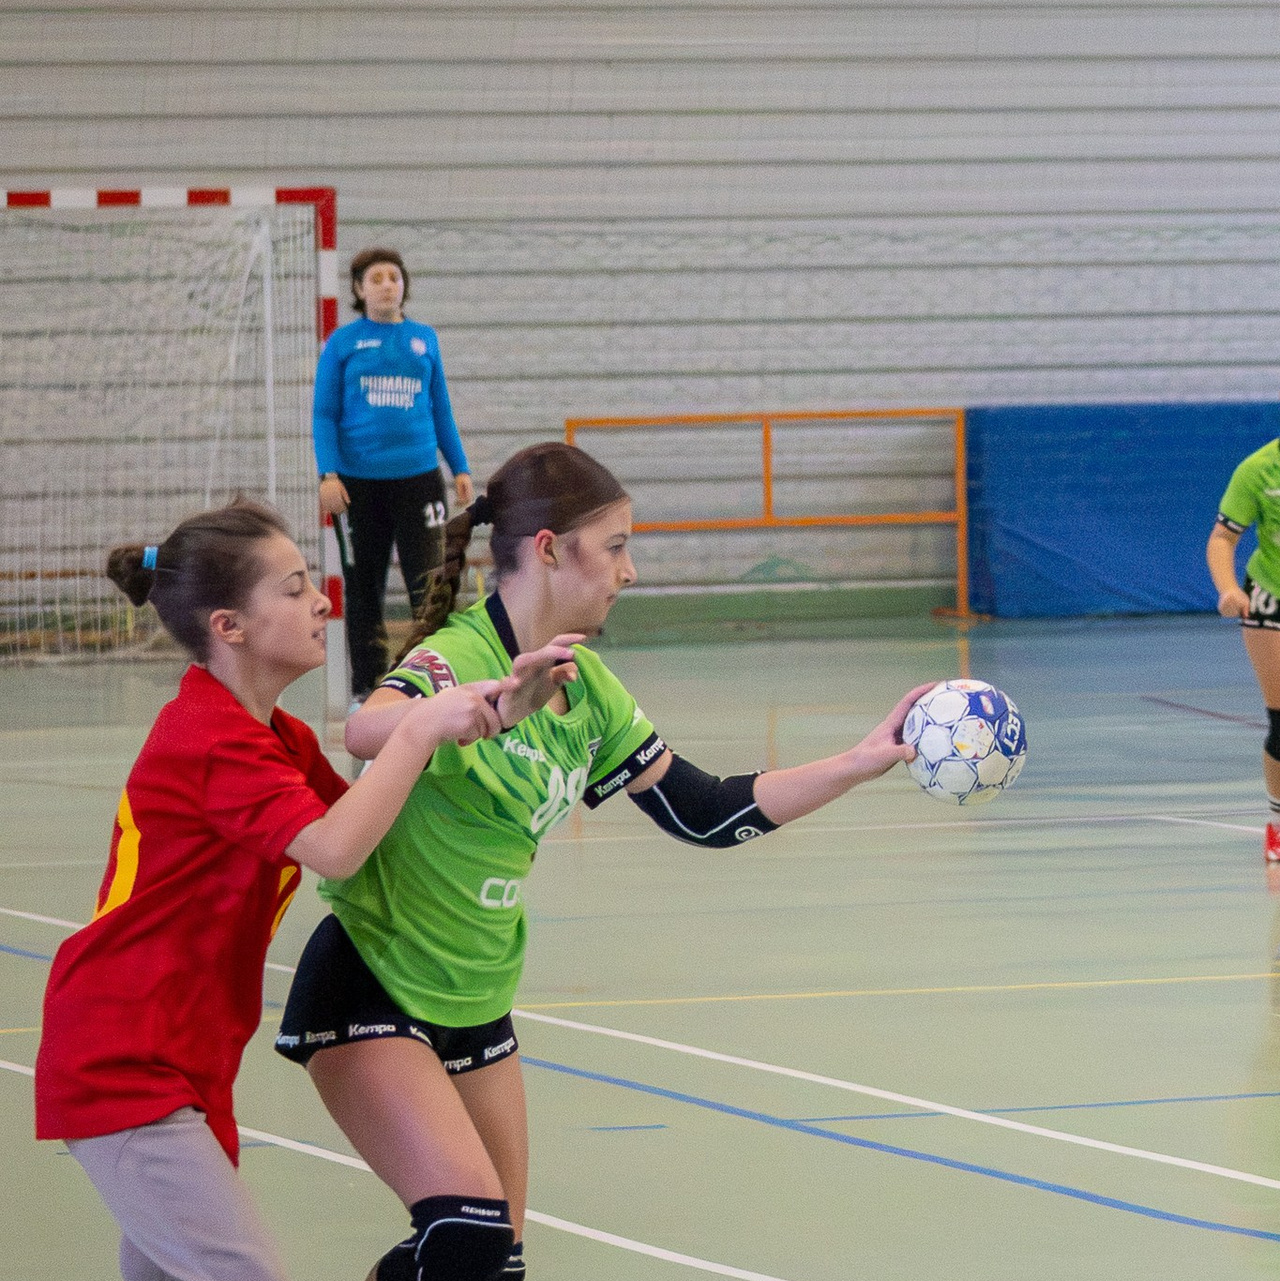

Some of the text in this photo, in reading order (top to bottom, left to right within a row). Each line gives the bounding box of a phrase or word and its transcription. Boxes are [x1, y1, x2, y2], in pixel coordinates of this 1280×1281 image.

[425, 501, 446, 528] 12
[594, 769, 632, 798] Kempa
[348, 1023, 396, 1038] Kempa
